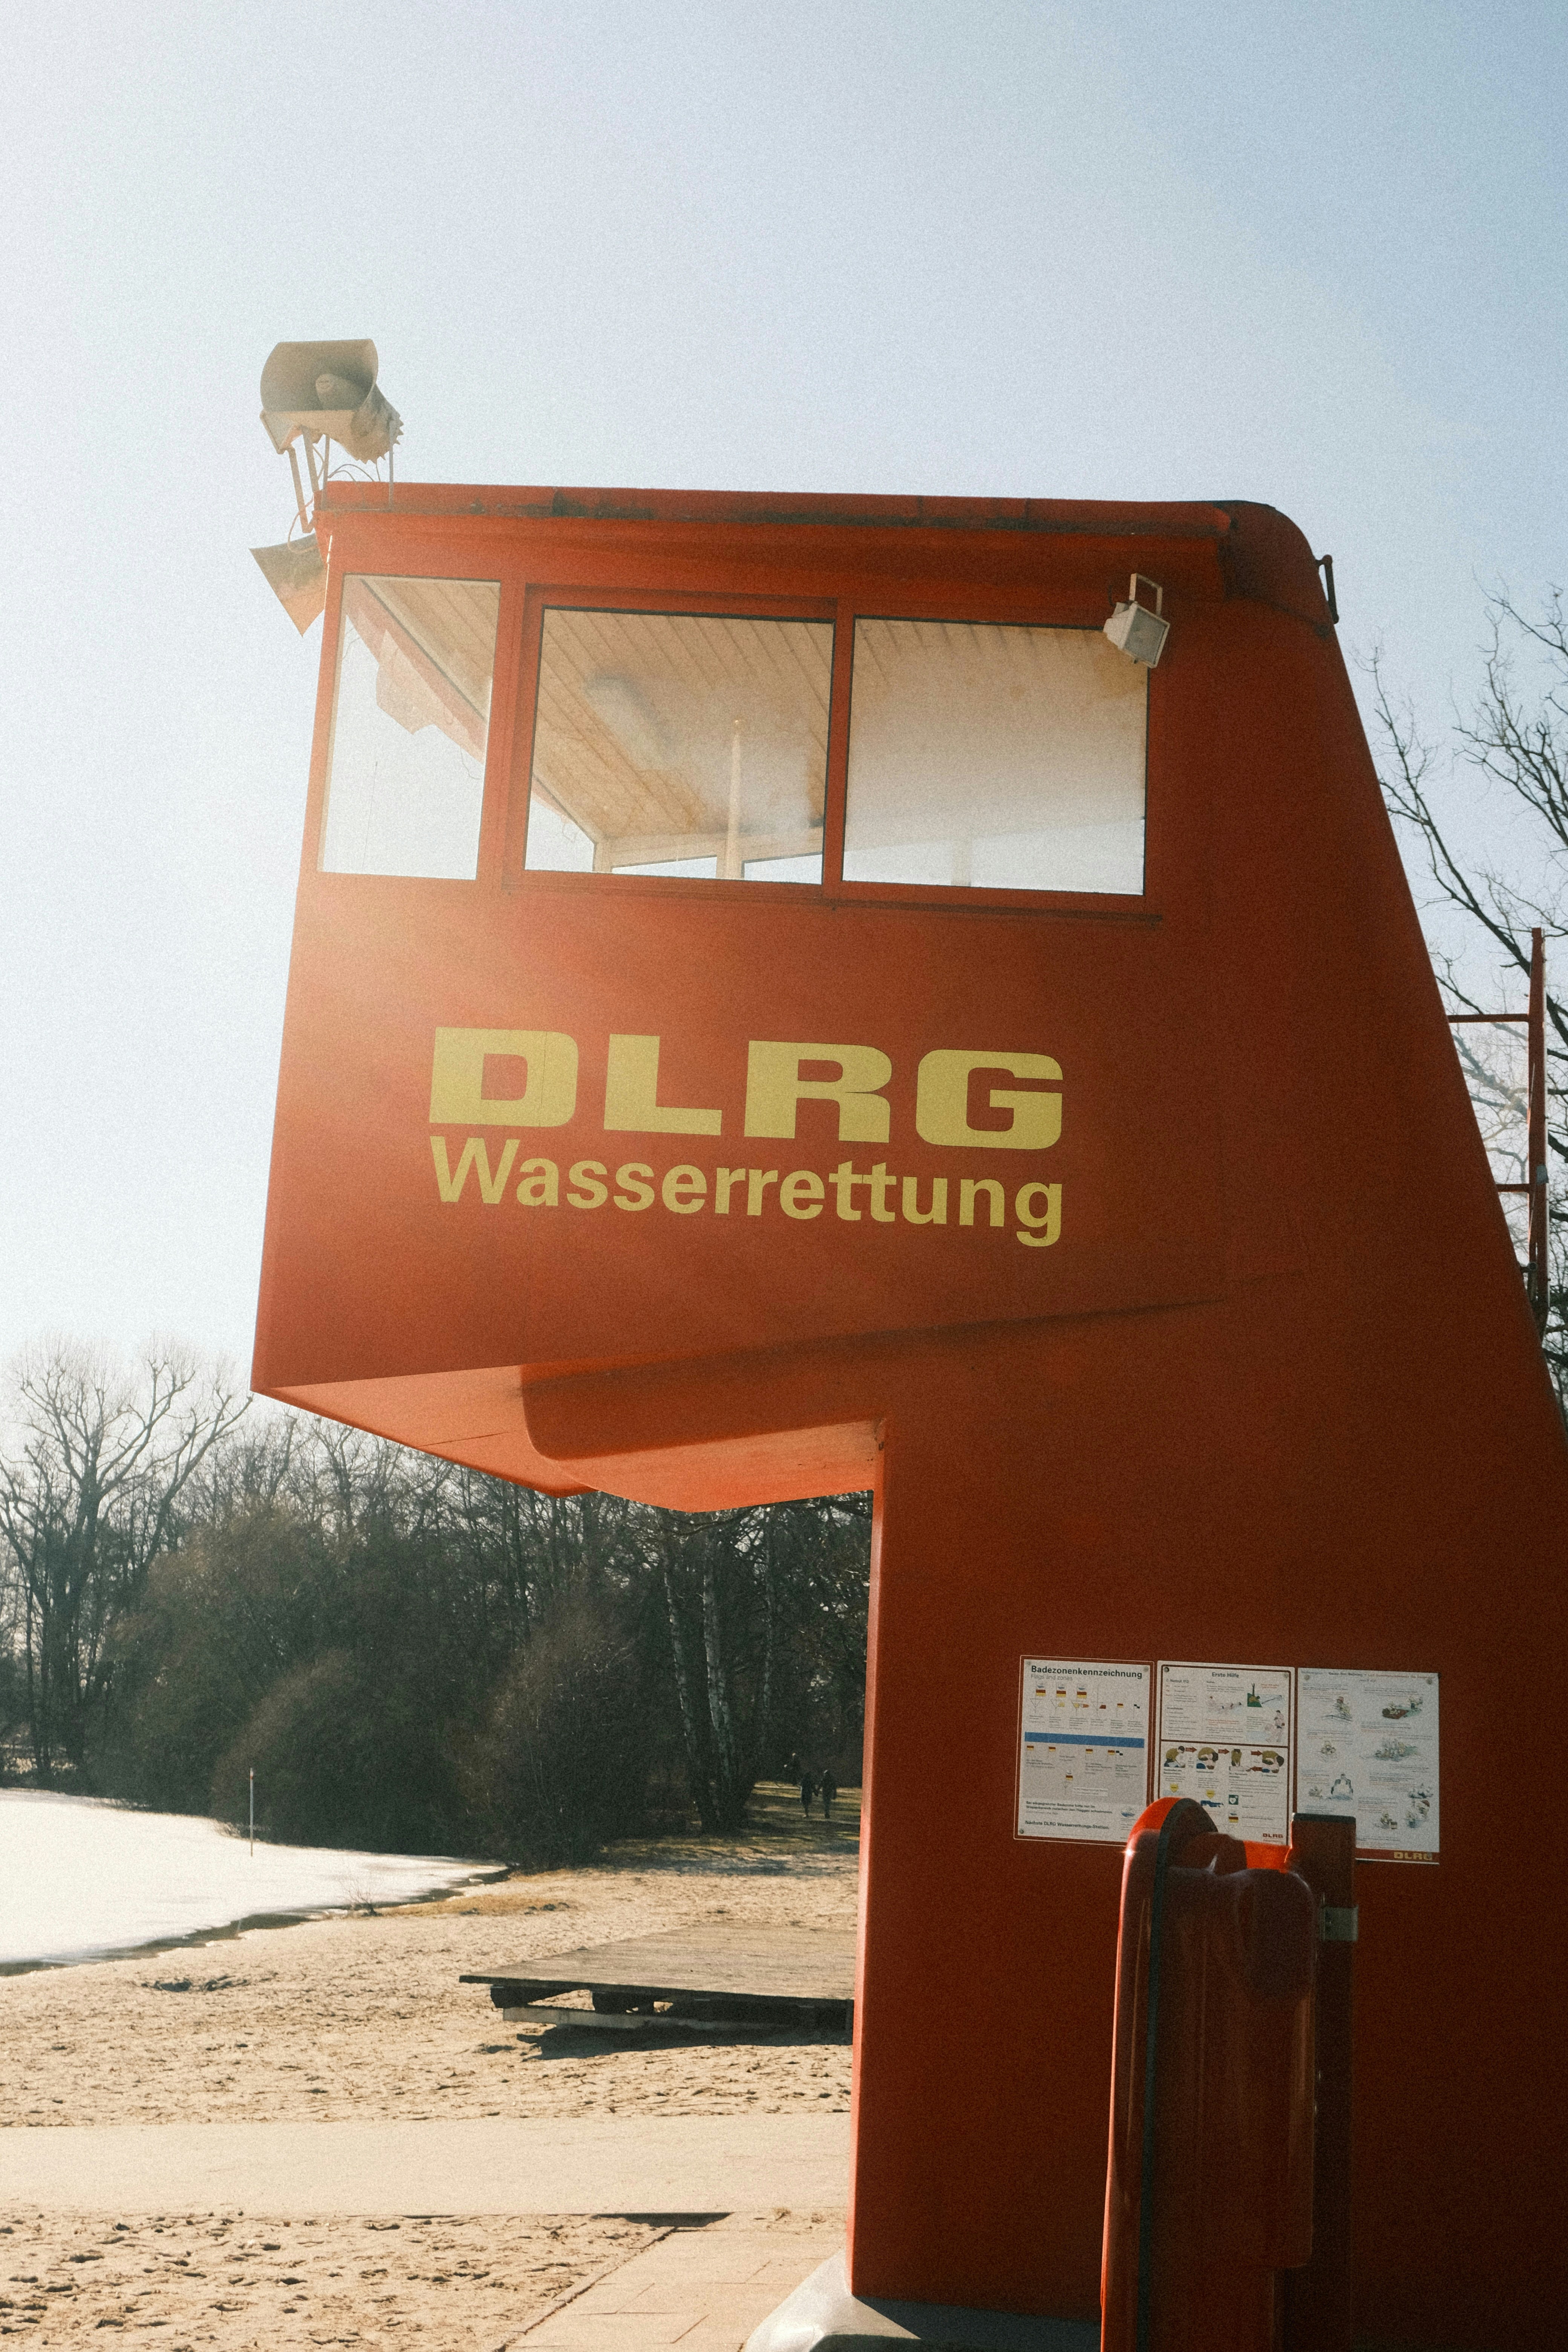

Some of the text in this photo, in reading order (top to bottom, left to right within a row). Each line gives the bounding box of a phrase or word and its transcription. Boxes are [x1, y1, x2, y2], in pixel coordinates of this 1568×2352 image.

[429, 1027, 1063, 1150] DLRG
[429, 1135, 1062, 1246] Wasserrettung
[1031, 1665, 1142, 1679] Badezonenkennzeichnung
